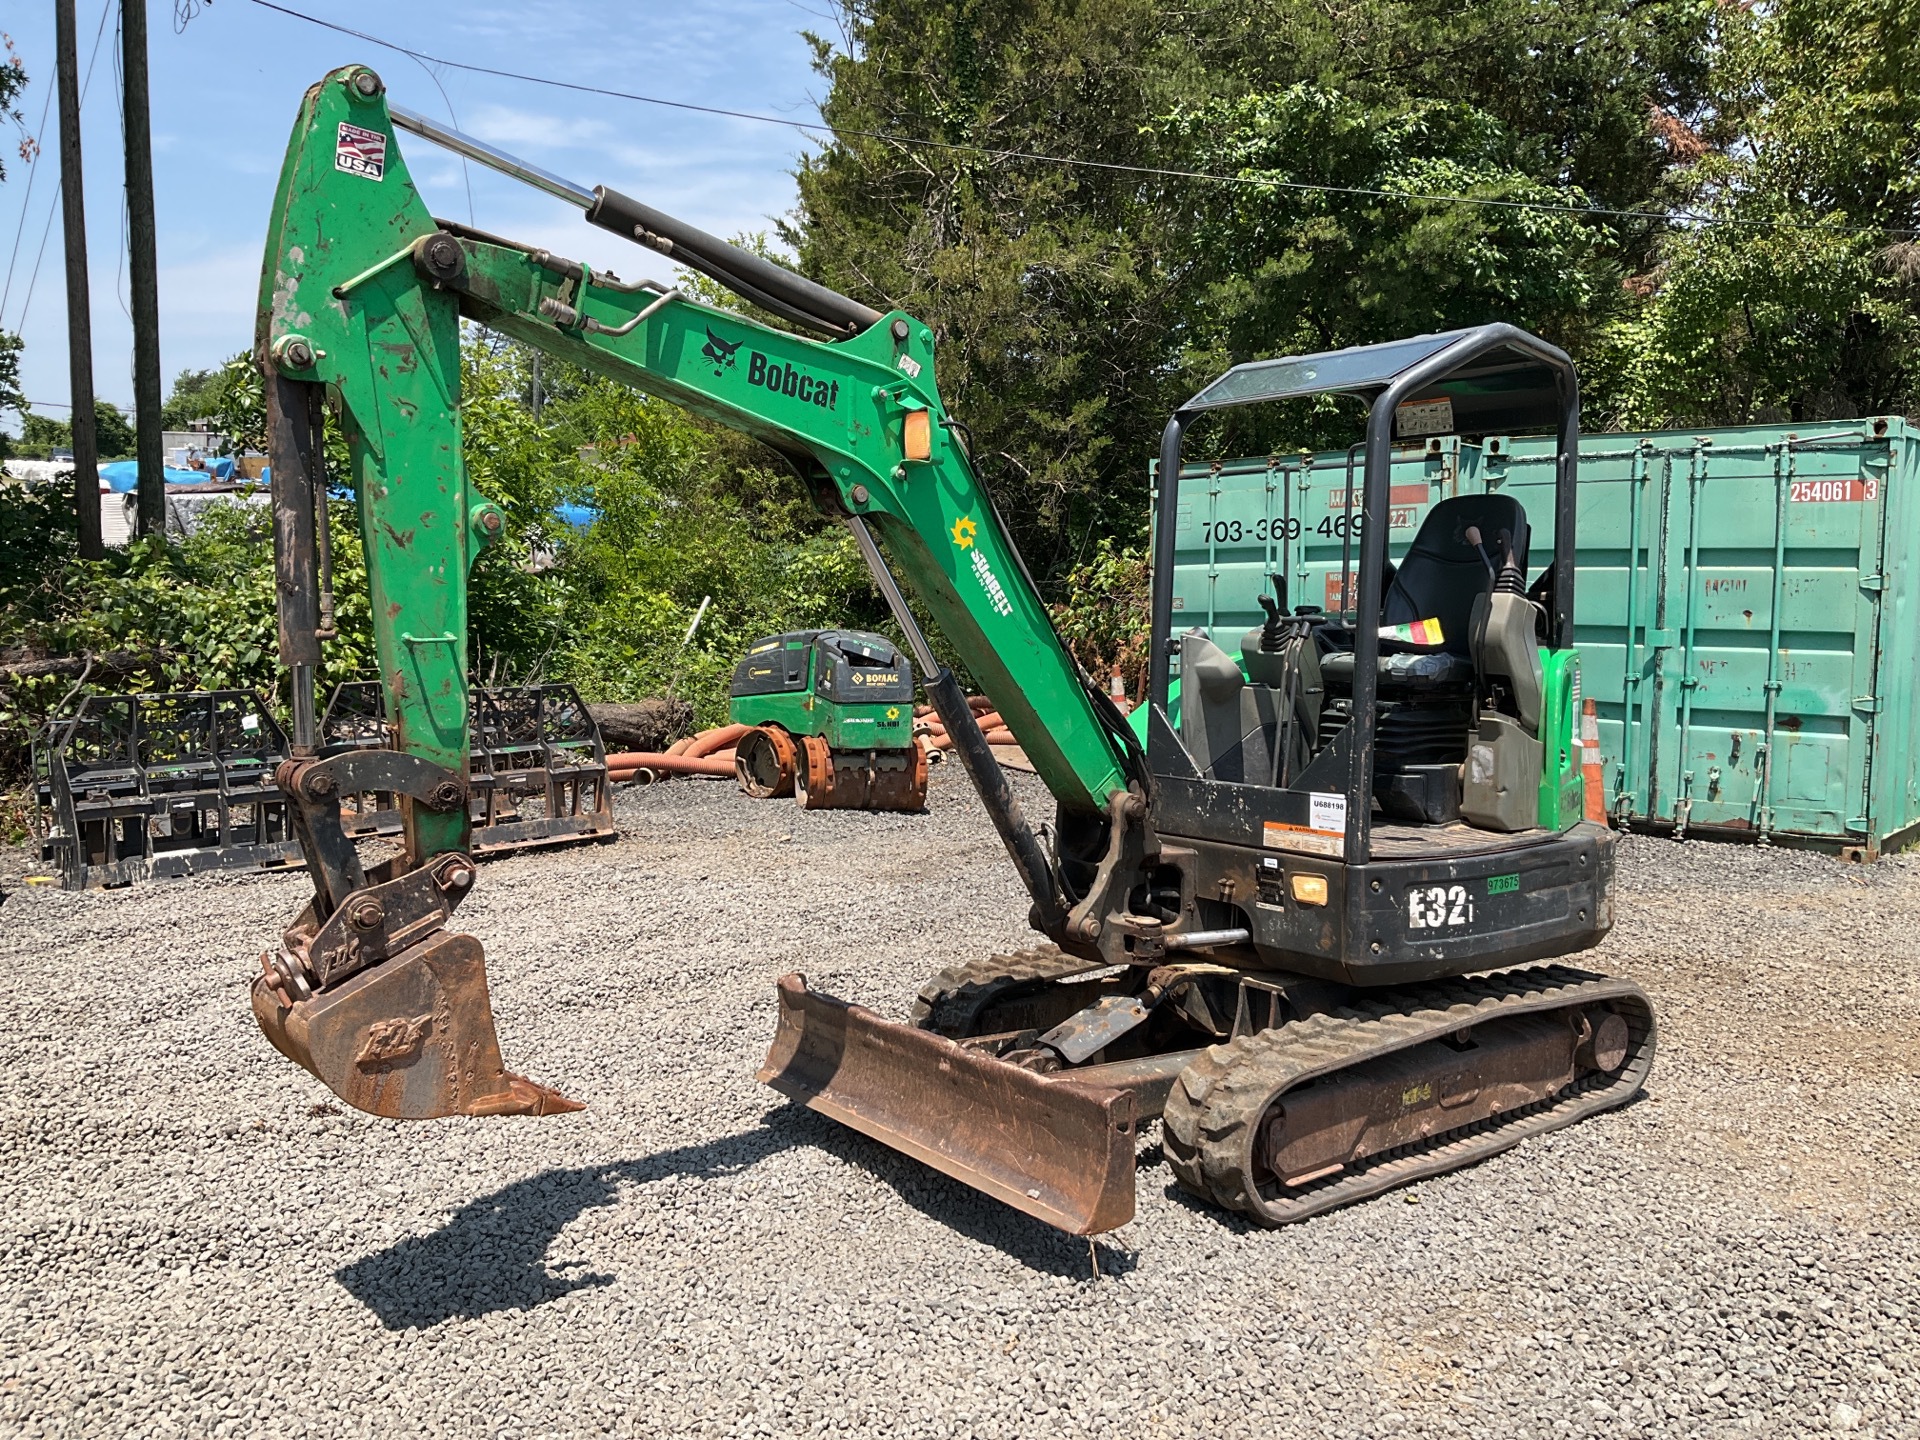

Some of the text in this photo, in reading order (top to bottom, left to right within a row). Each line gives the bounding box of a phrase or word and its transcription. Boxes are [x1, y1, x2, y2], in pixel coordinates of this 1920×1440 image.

[341, 125, 360, 136] MADE
[339, 155, 379, 176] USA
[747, 351, 840, 412] Bobcat
[1790, 480, 1877, 502] 254061 3
[970, 548, 1014, 617] SUNBELT
[970, 564, 999, 613] RENTALS
[866, 674, 899, 682] BOMAG
[1313, 800, 1344, 811] U688198
[1294, 826, 1319, 834] WARNING
[1488, 876, 1519, 891] 973675
[1409, 885, 1474, 928] E32i
